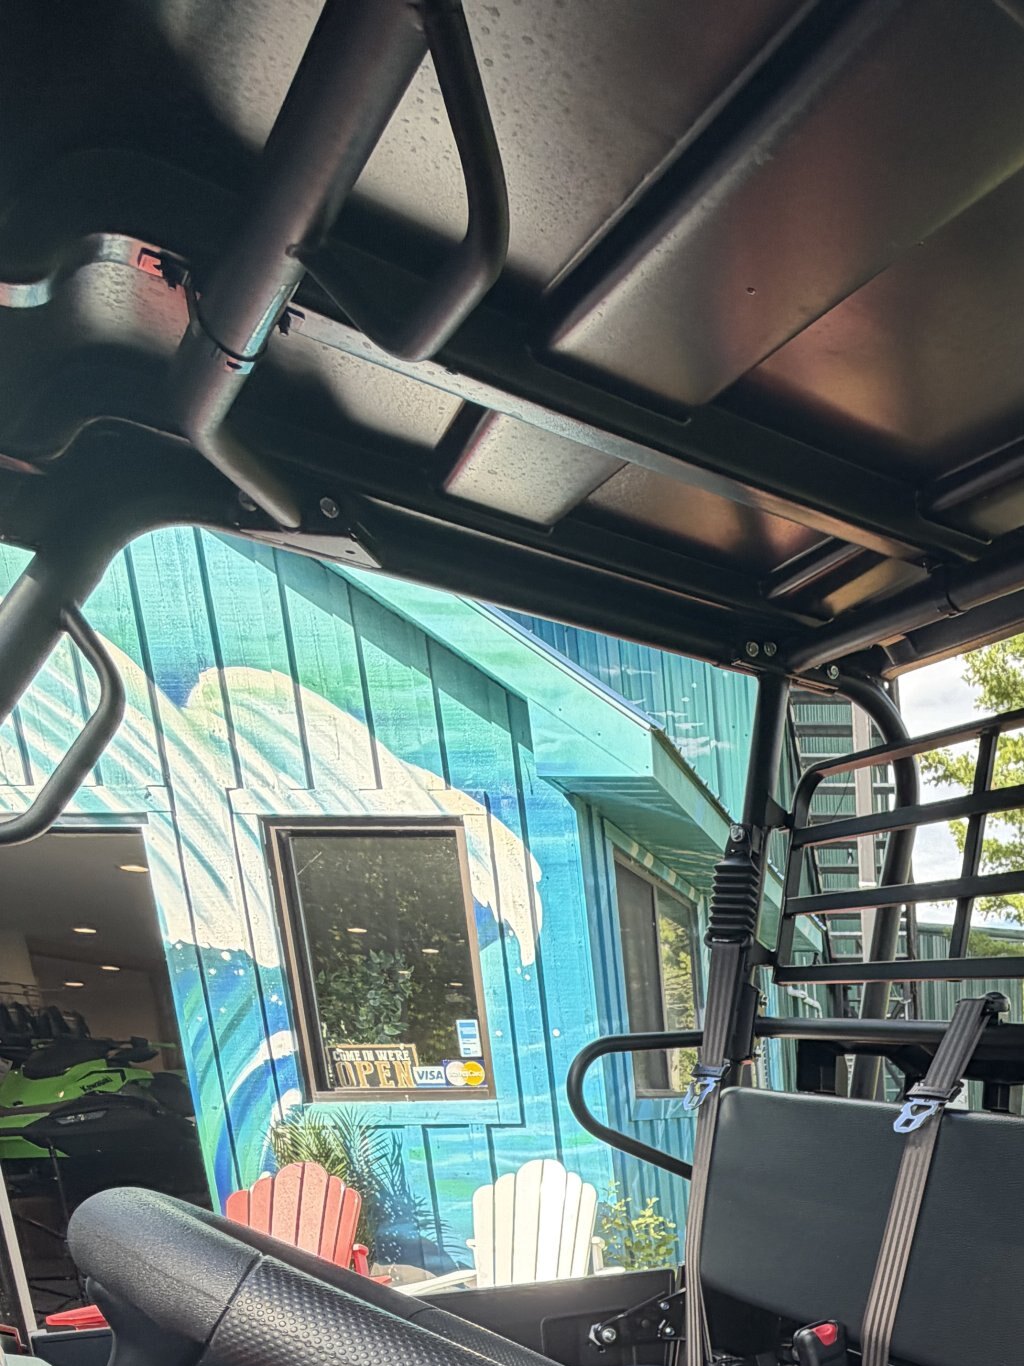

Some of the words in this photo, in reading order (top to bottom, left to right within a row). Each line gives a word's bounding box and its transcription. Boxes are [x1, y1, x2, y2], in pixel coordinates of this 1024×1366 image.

[332, 1049, 361, 1061] COME
[362, 1050, 375, 1061] IN
[335, 1061, 415, 1088] OPEN
[417, 1070, 443, 1080] VISA
